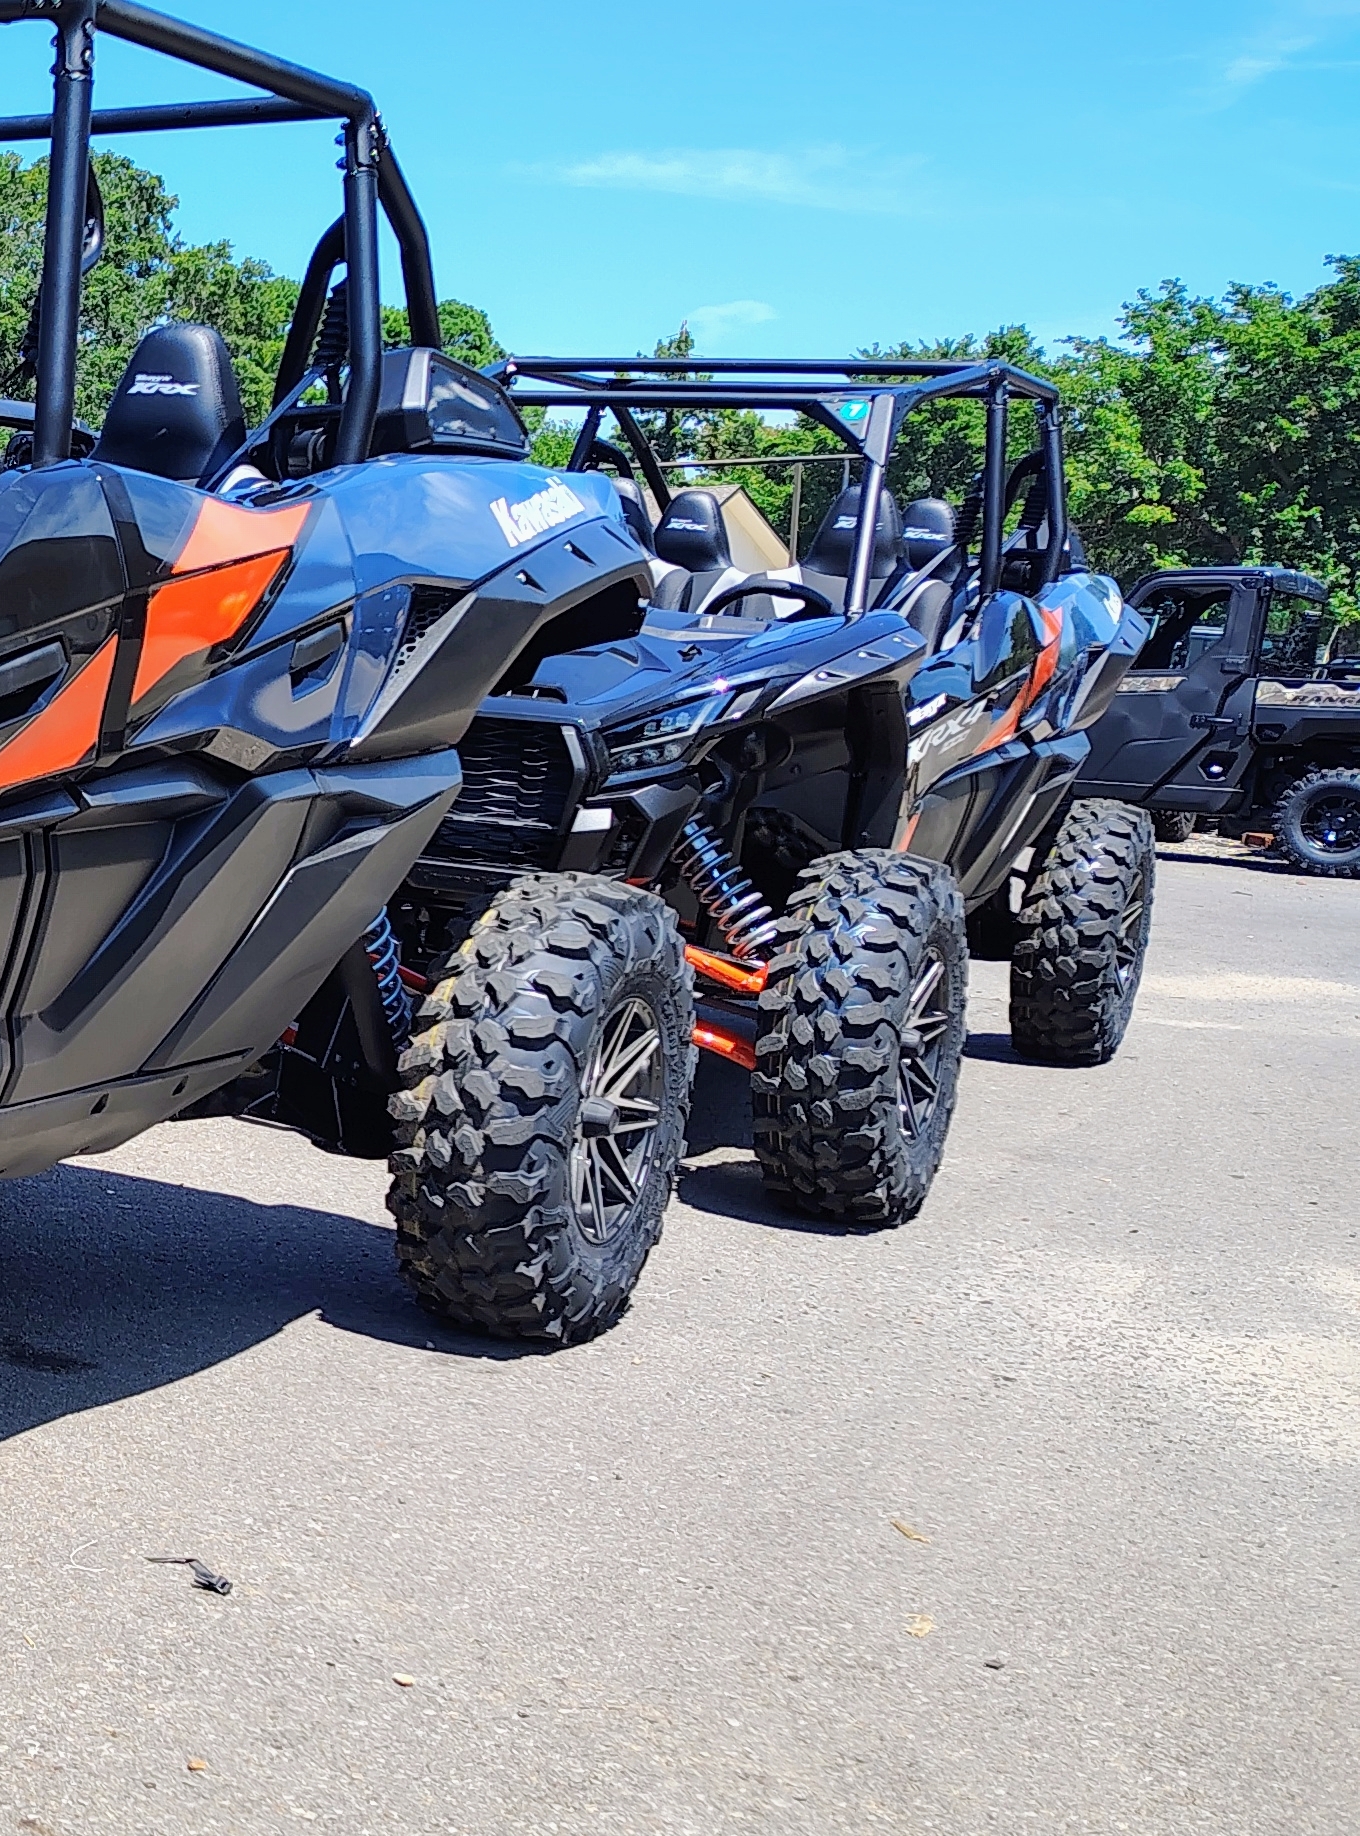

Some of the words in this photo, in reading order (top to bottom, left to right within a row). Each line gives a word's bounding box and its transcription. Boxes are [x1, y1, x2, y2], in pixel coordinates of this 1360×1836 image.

[126, 382, 201, 396] KRX
[489, 475, 586, 548] Kawasaki
[1291, 695, 1360, 705] RANG
